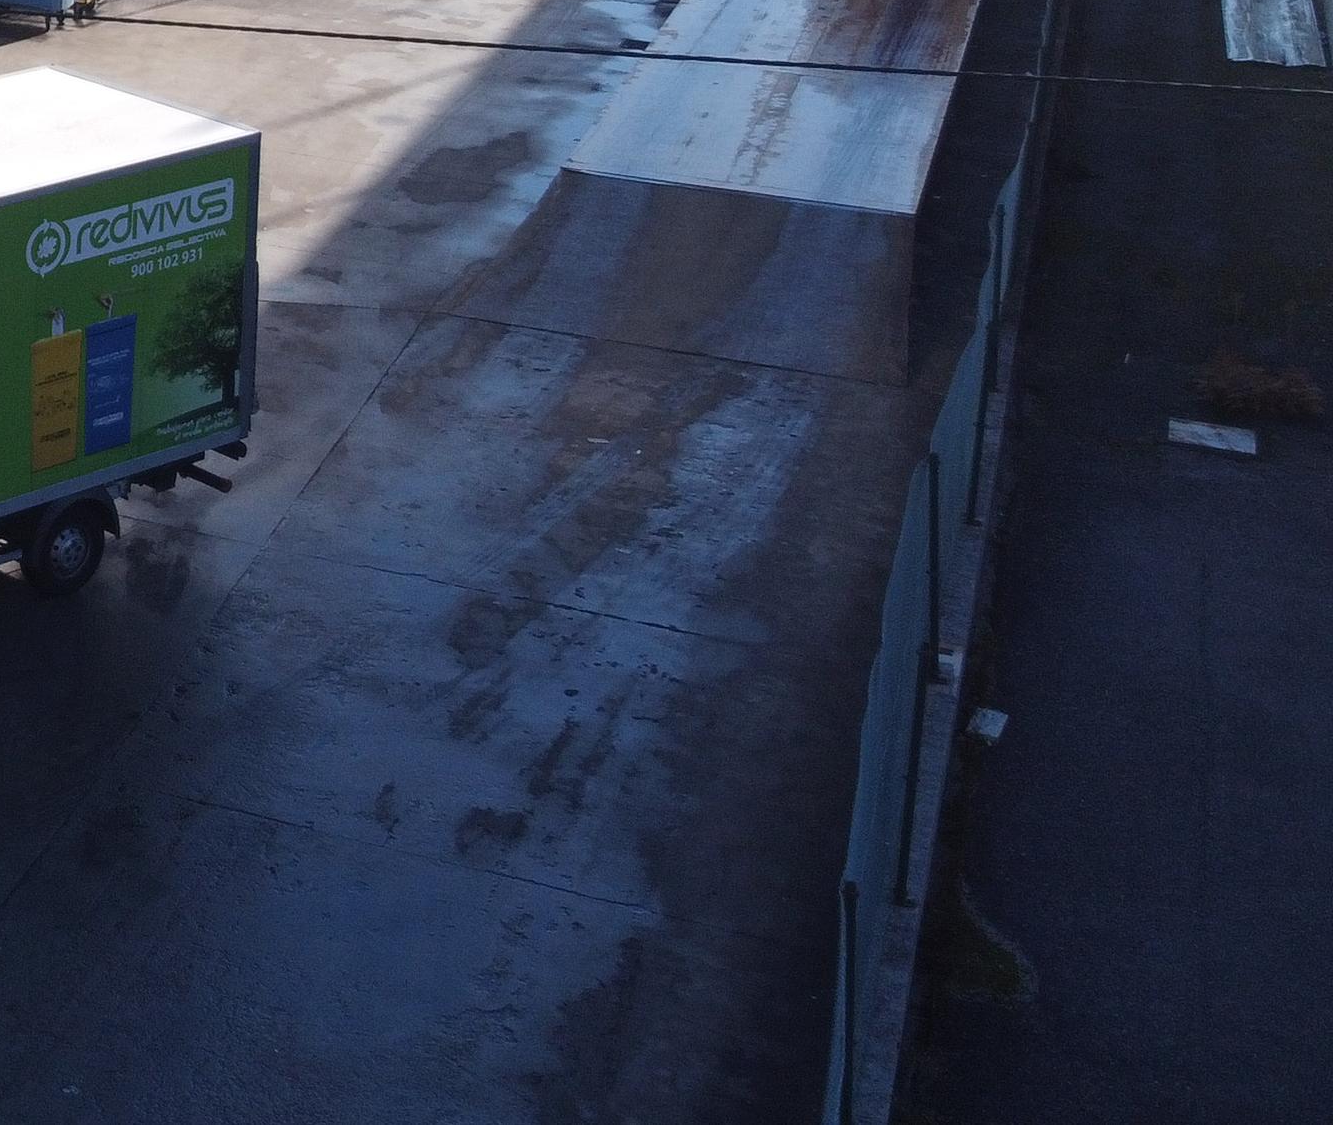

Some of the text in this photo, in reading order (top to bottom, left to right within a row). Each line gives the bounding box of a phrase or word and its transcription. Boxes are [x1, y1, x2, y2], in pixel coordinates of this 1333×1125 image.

[76, 186, 228, 255] redivivus
[131, 247, 203, 278] 900 102 931
